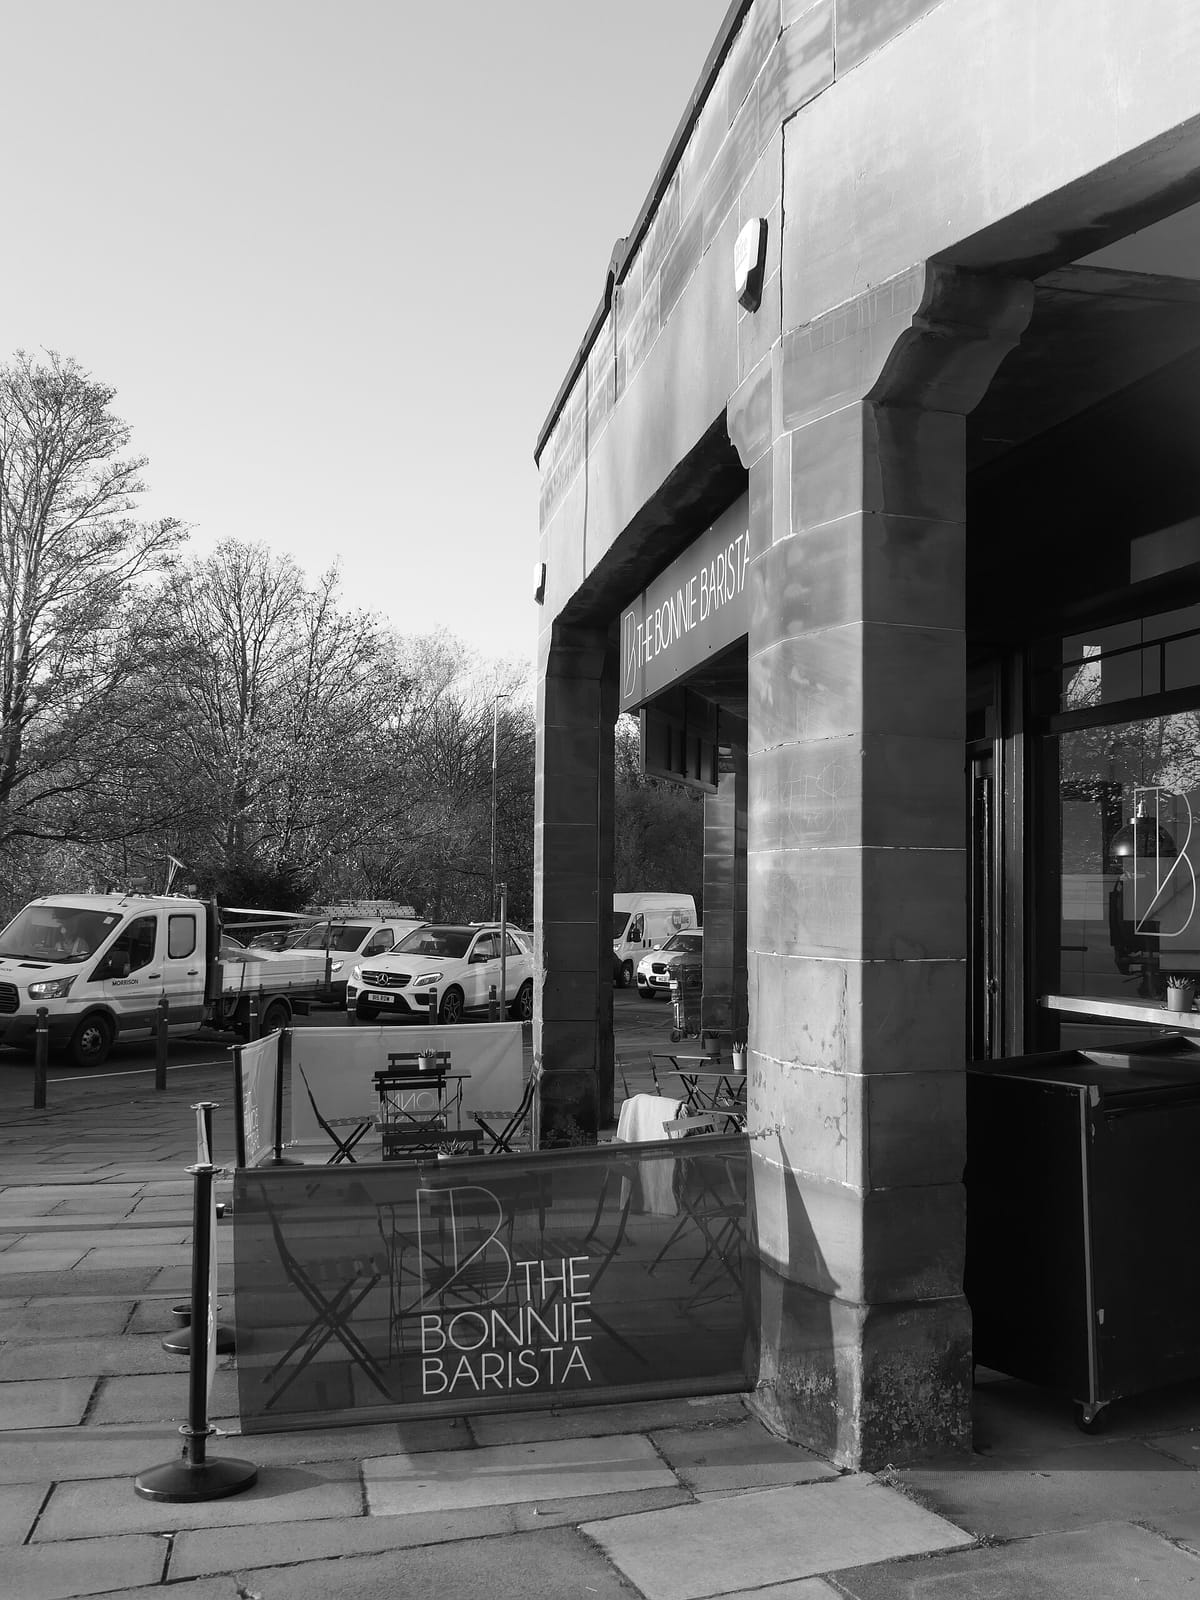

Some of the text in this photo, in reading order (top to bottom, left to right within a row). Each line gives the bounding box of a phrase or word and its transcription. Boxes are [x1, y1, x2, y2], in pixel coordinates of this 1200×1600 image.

[637, 529, 750, 668] THE BONNIE BARISTA
[516, 1255, 591, 1301] THE
[421, 1301, 592, 1354] BONNIE
[421, 1345, 592, 1395] BARISTA
